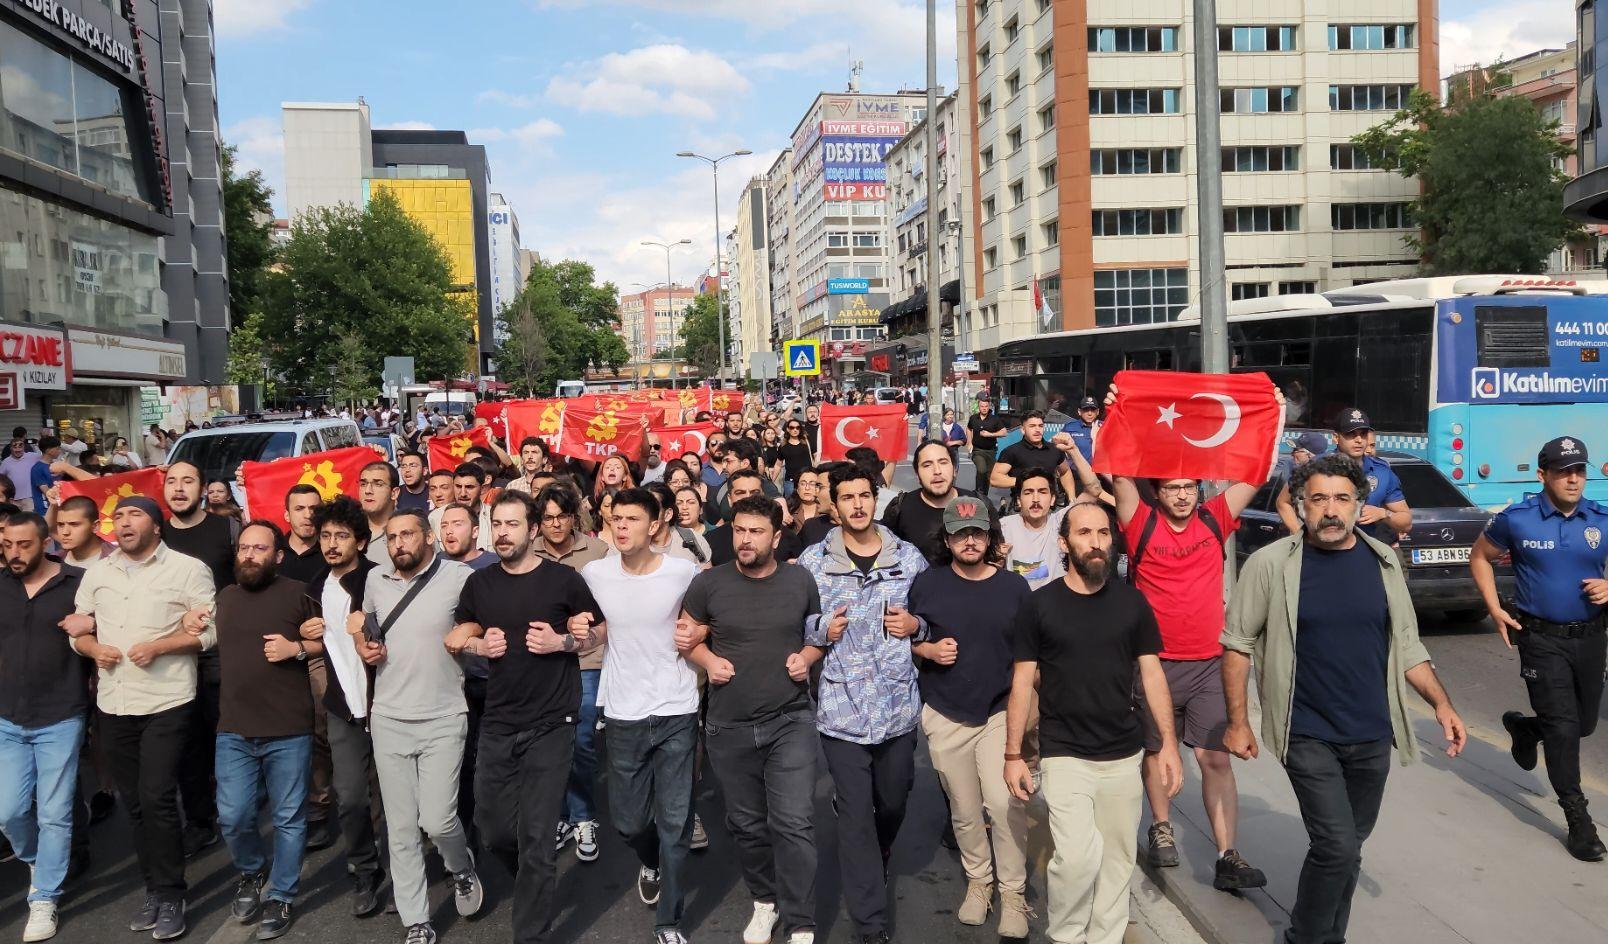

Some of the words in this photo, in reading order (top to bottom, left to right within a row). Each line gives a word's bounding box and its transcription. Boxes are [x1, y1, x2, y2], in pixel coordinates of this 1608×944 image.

[856, 97, 900, 112] İVME
[828, 120, 857, 133] İVME
[860, 121, 901, 134] EĞİTİM
[825, 142, 880, 162] DESTEK
[828, 180, 857, 198] VİP
[863, 185, 886, 198] KU
[830, 281, 868, 290] TUSWORLD
[1555, 321, 1580, 335] 444
[1582, 322, 1594, 335] 11
[29, 370, 57, 385] KIZILAY
[584, 441, 618, 456] TKP
[956, 502, 977, 518] W
[1420, 550, 1433, 561] 53
